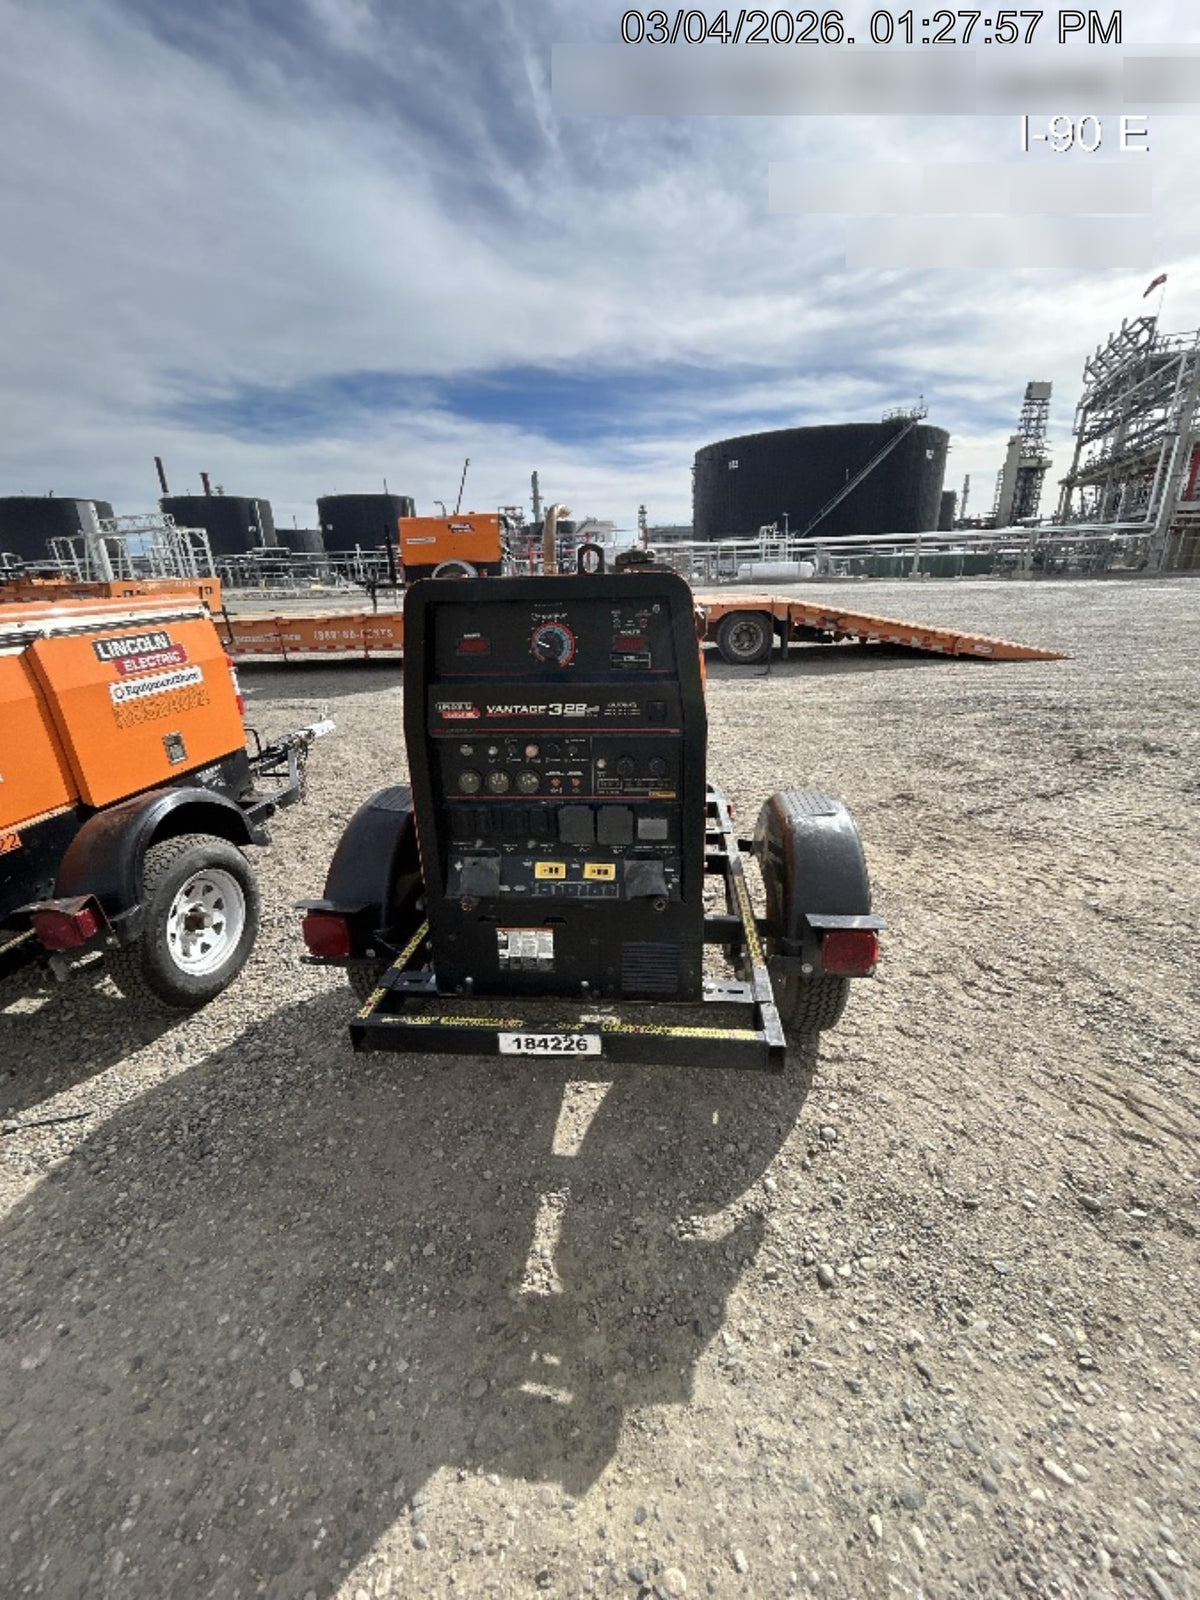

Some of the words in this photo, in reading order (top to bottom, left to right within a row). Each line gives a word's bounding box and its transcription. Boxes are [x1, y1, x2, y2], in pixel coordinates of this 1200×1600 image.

[96, 632, 170, 659] LINCOLN
[121, 650, 182, 672] ELECTRIC
[486, 704, 547, 716] VANTAGE
[512, 1035, 588, 1052] 184226
